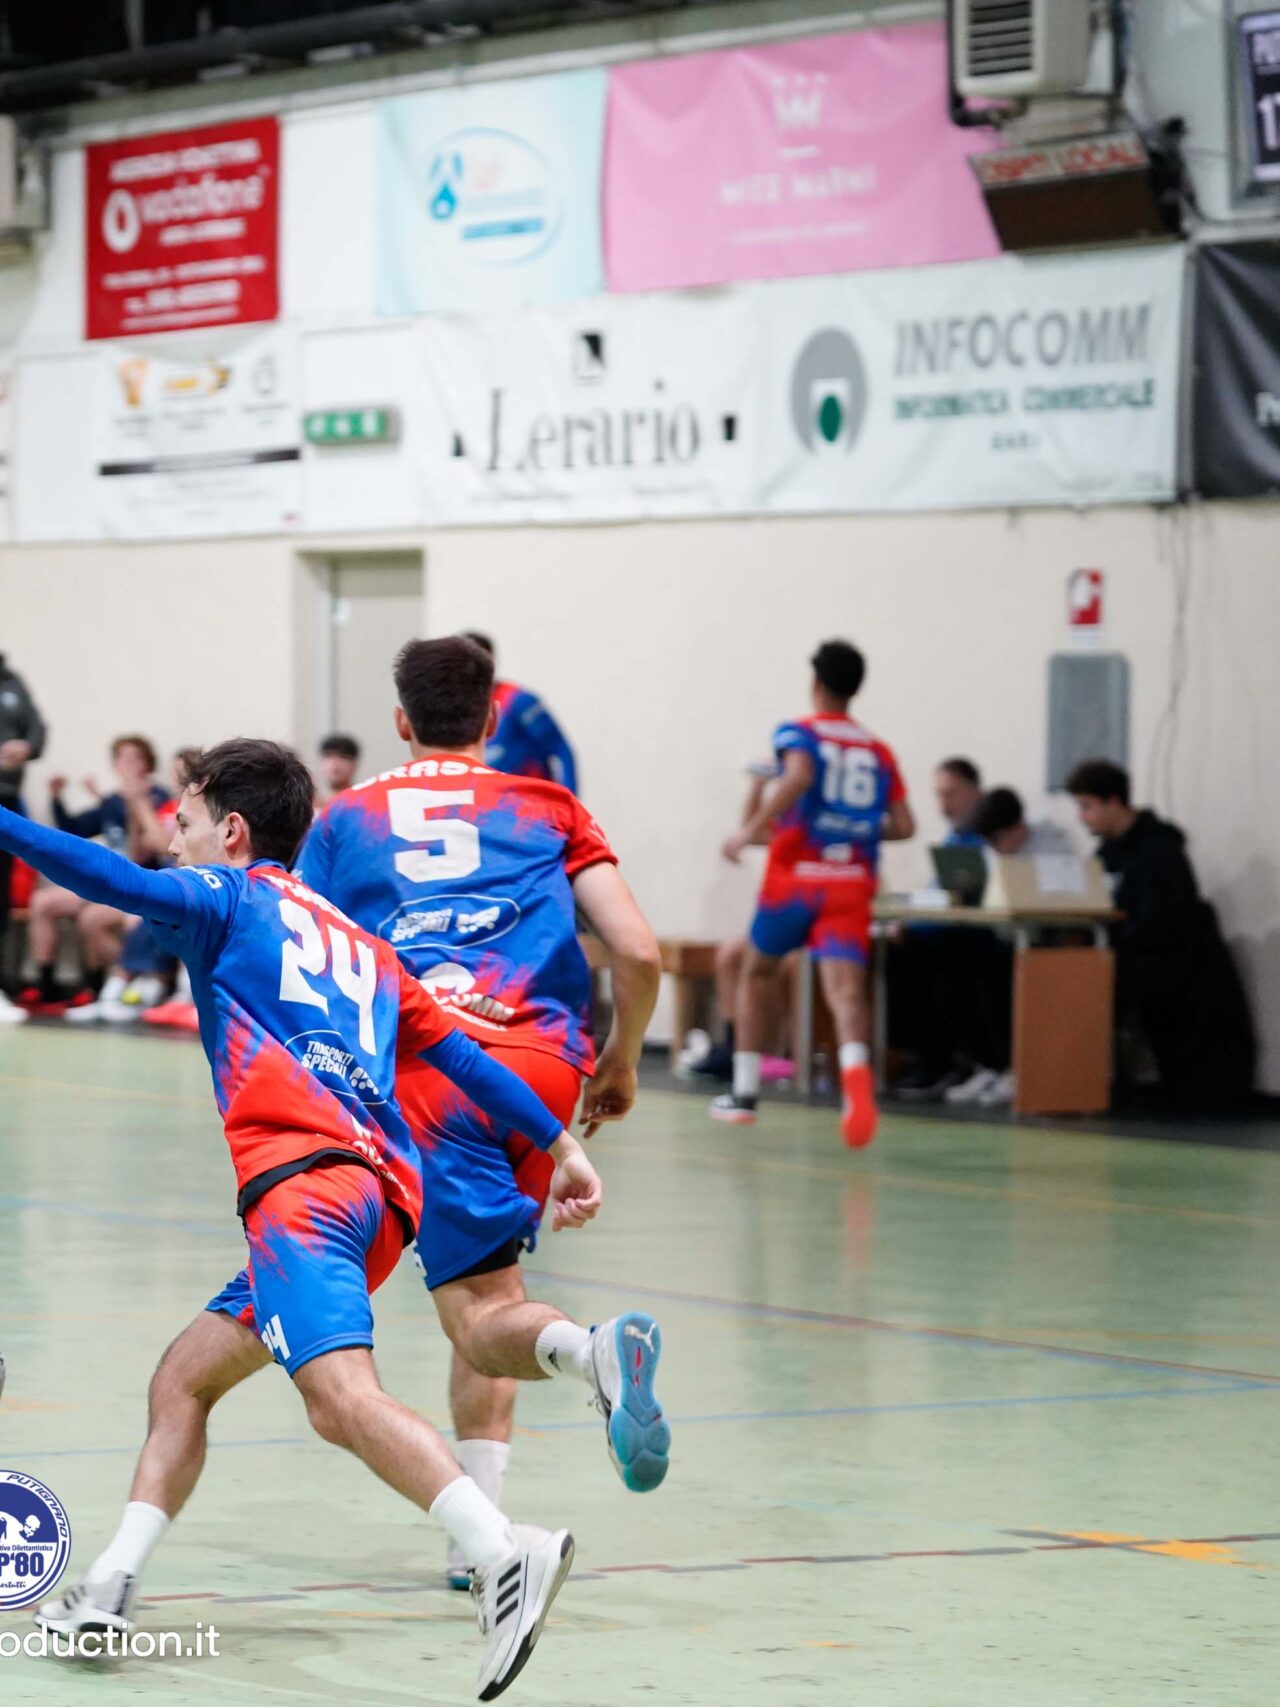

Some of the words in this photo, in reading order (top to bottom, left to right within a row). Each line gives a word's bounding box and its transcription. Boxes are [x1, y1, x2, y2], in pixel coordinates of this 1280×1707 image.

[894, 304, 1151, 377] INFOCOMM
[487, 378, 700, 472] Lerario
[895, 389, 1009, 419] INFORMATICA
[1023, 378, 1155, 412] COMMERCIALE
[819, 739, 878, 810] 16
[387, 787, 482, 883] 5
[278, 898, 377, 1056] 24
